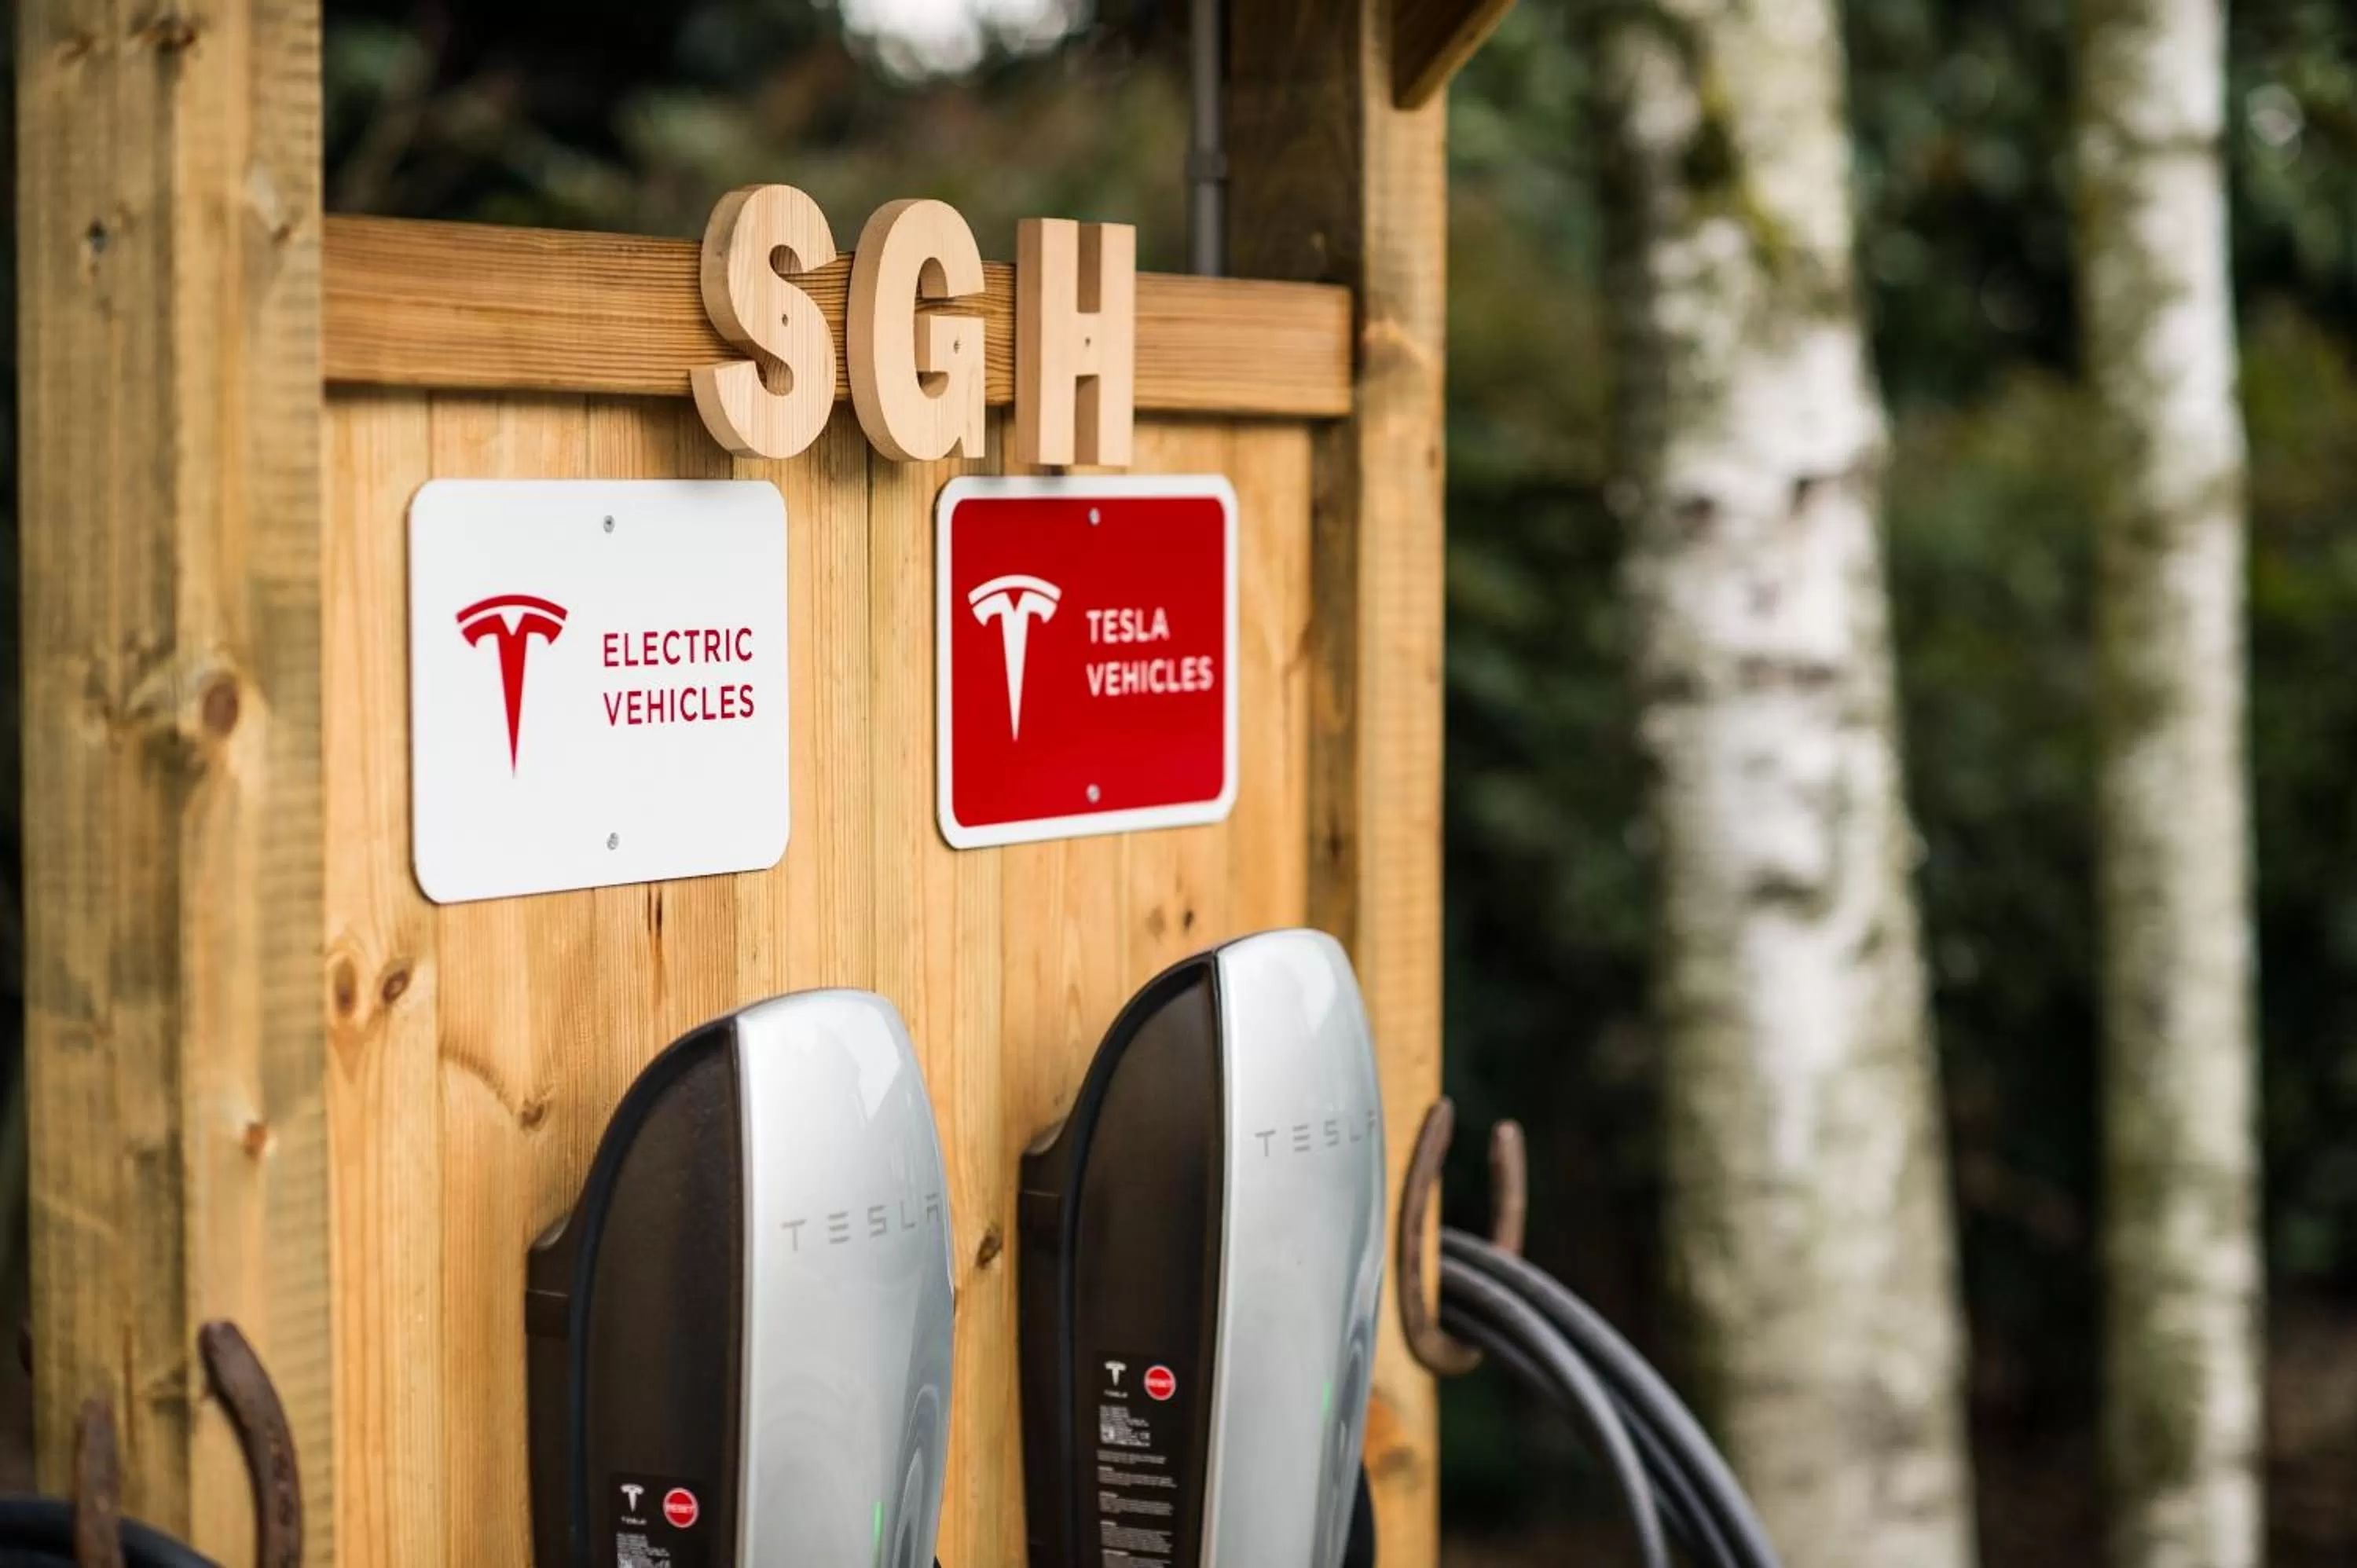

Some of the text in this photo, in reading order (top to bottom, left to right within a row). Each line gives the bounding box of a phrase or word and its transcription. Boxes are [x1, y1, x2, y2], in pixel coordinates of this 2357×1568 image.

[691, 184, 1135, 465] SGH
[1086, 606, 1170, 644] TESLA
[603, 628, 752, 666] ELECTRIC
[1086, 655, 1214, 697] VEHICLES
[603, 684, 754, 726] VEHICLES
[780, 1192, 940, 1251] TESLA
